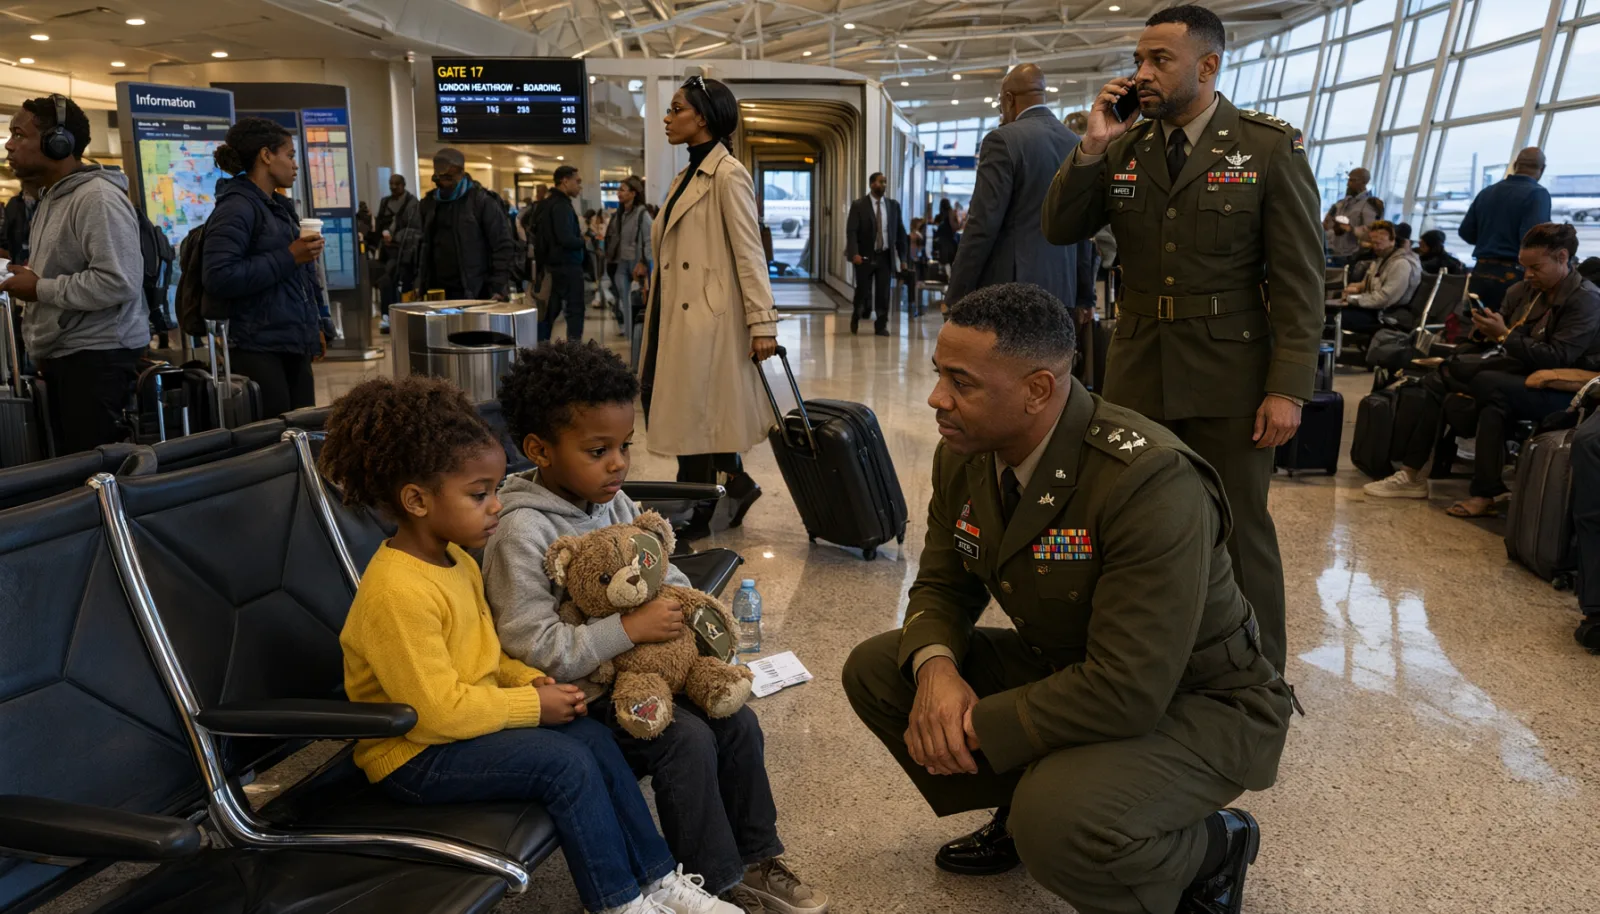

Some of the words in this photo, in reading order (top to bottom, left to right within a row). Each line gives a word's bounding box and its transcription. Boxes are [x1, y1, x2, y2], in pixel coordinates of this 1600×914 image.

[438, 66, 467, 78] GATE
[470, 66, 484, 78] 17
[438, 83, 470, 92] LONDON
[471, 83, 513, 92] HEATHROW
[523, 83, 562, 92] BOARDING
[136, 93, 196, 108] Information
